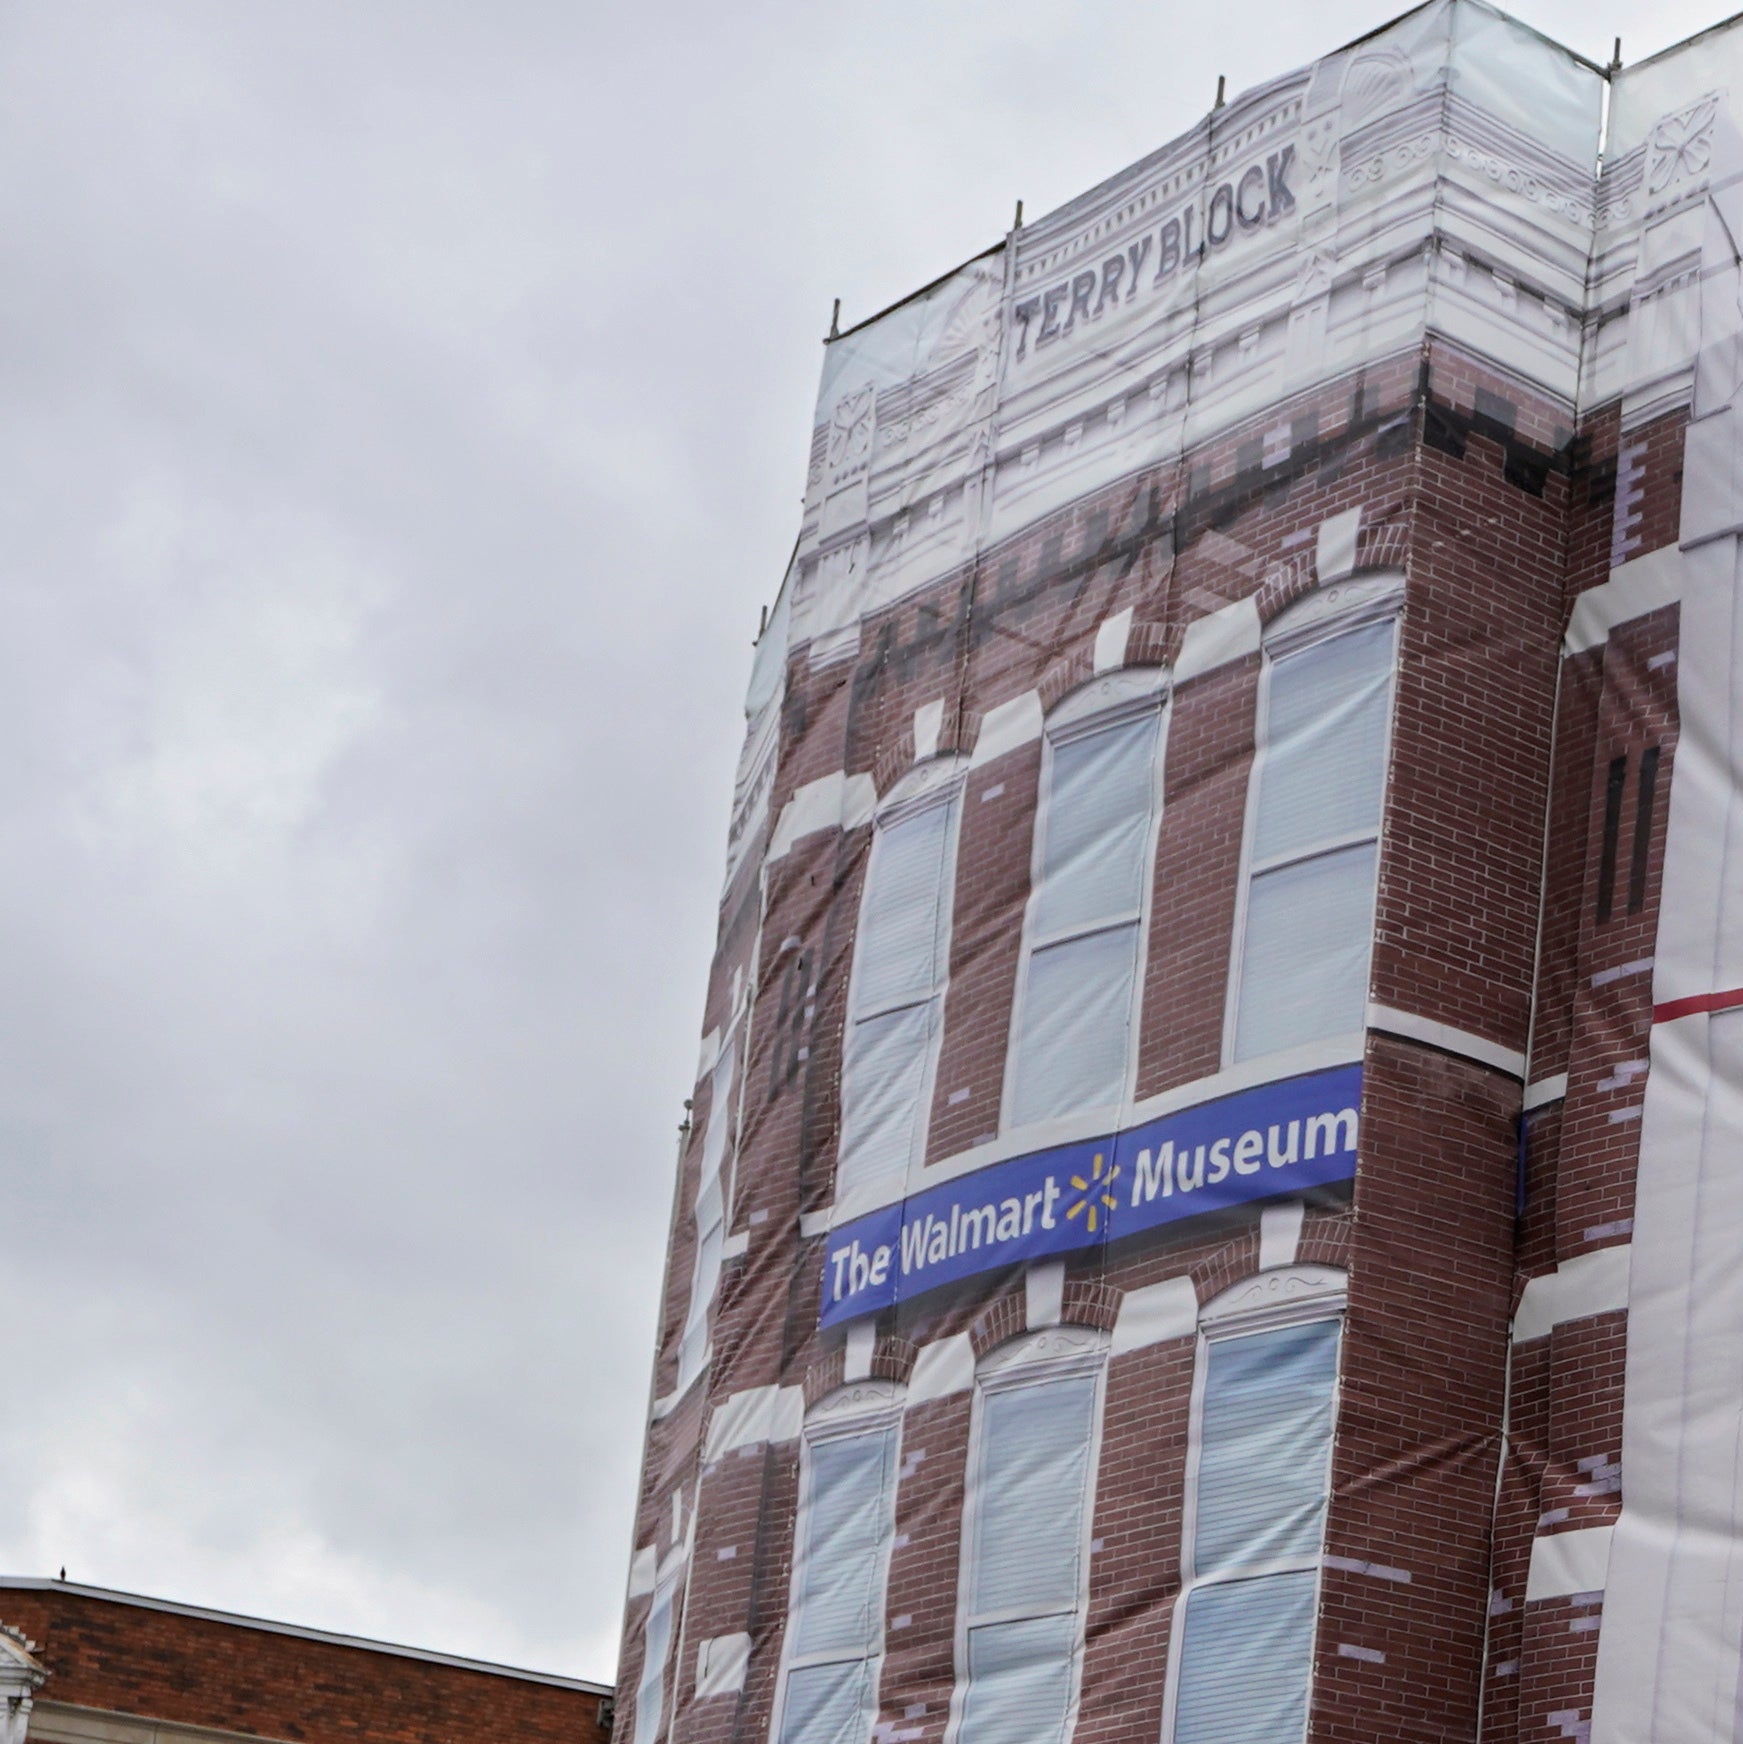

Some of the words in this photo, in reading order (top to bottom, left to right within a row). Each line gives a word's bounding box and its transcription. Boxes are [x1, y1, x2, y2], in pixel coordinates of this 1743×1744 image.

[1014, 233, 1153, 364] TERRY
[1153, 143, 1297, 284] BLOCK
[831, 1243, 889, 1301] The
[900, 1176, 1061, 1275] Walmart
[1130, 1106, 1358, 1208] Museum
